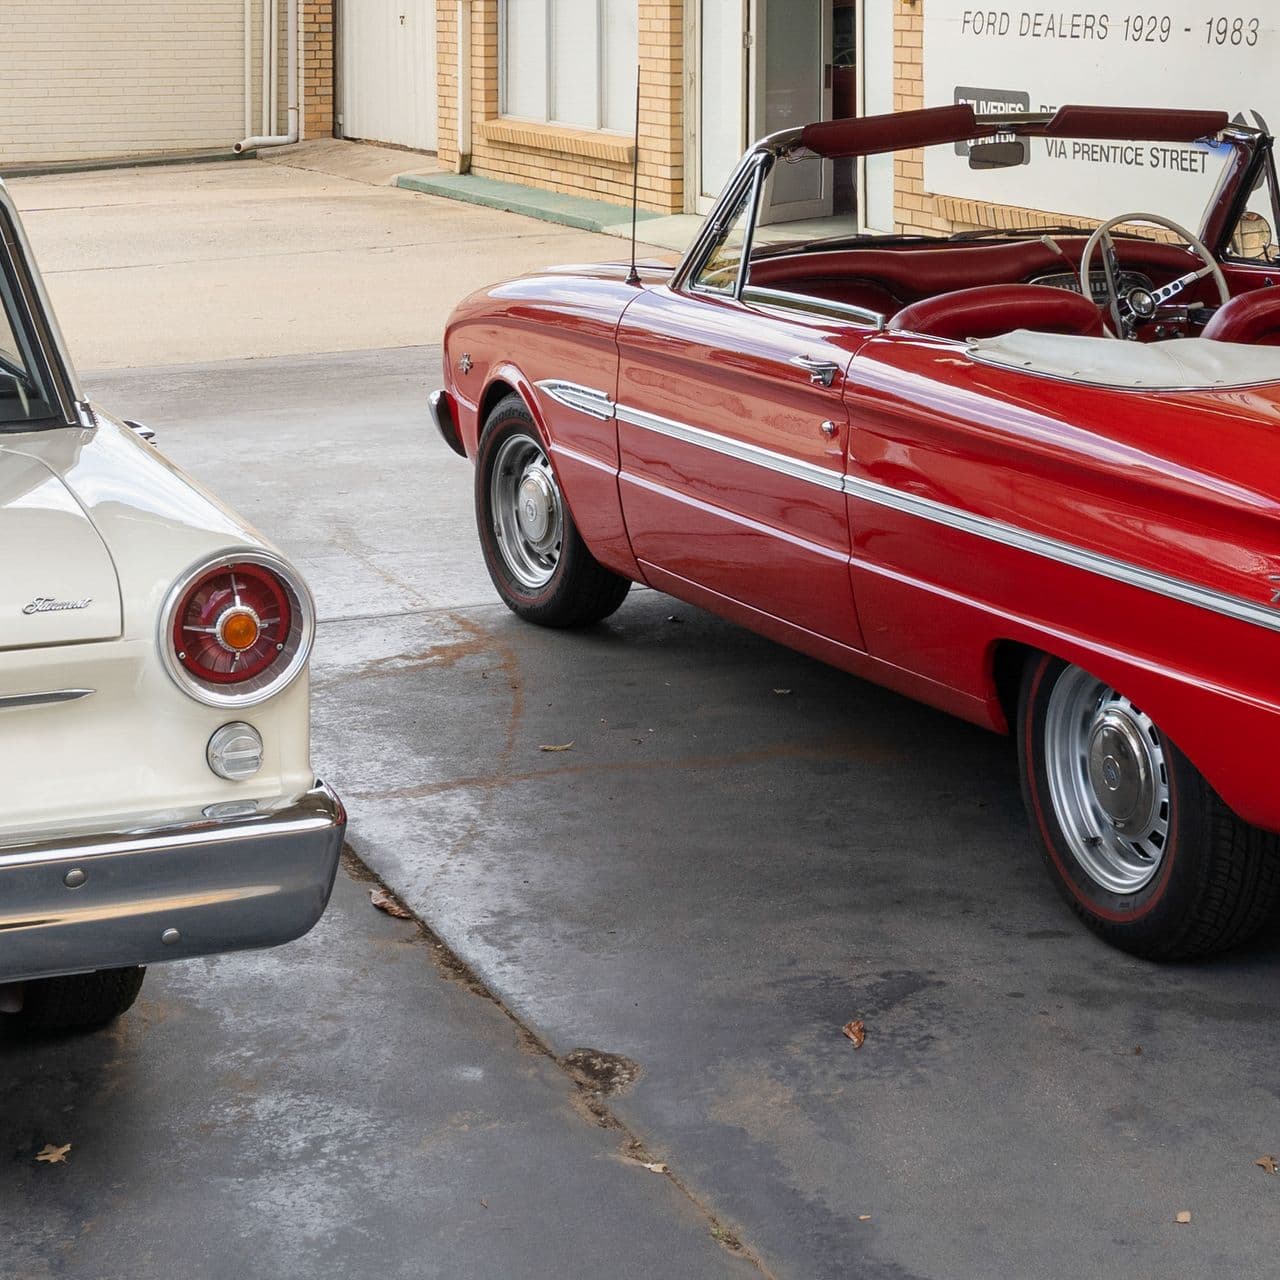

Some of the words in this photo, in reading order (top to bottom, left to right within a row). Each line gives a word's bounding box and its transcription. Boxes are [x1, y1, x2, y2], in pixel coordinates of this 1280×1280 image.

[961, 11, 1010, 36] FORD
[1019, 12, 1109, 41] DEALERS
[1122, 15, 1171, 43] 1929
[1205, 17, 1260, 47] 1983
[1045, 138, 1067, 159] VIA
[1073, 141, 1144, 166] PRENTICE
[1149, 147, 1209, 174] STREET
